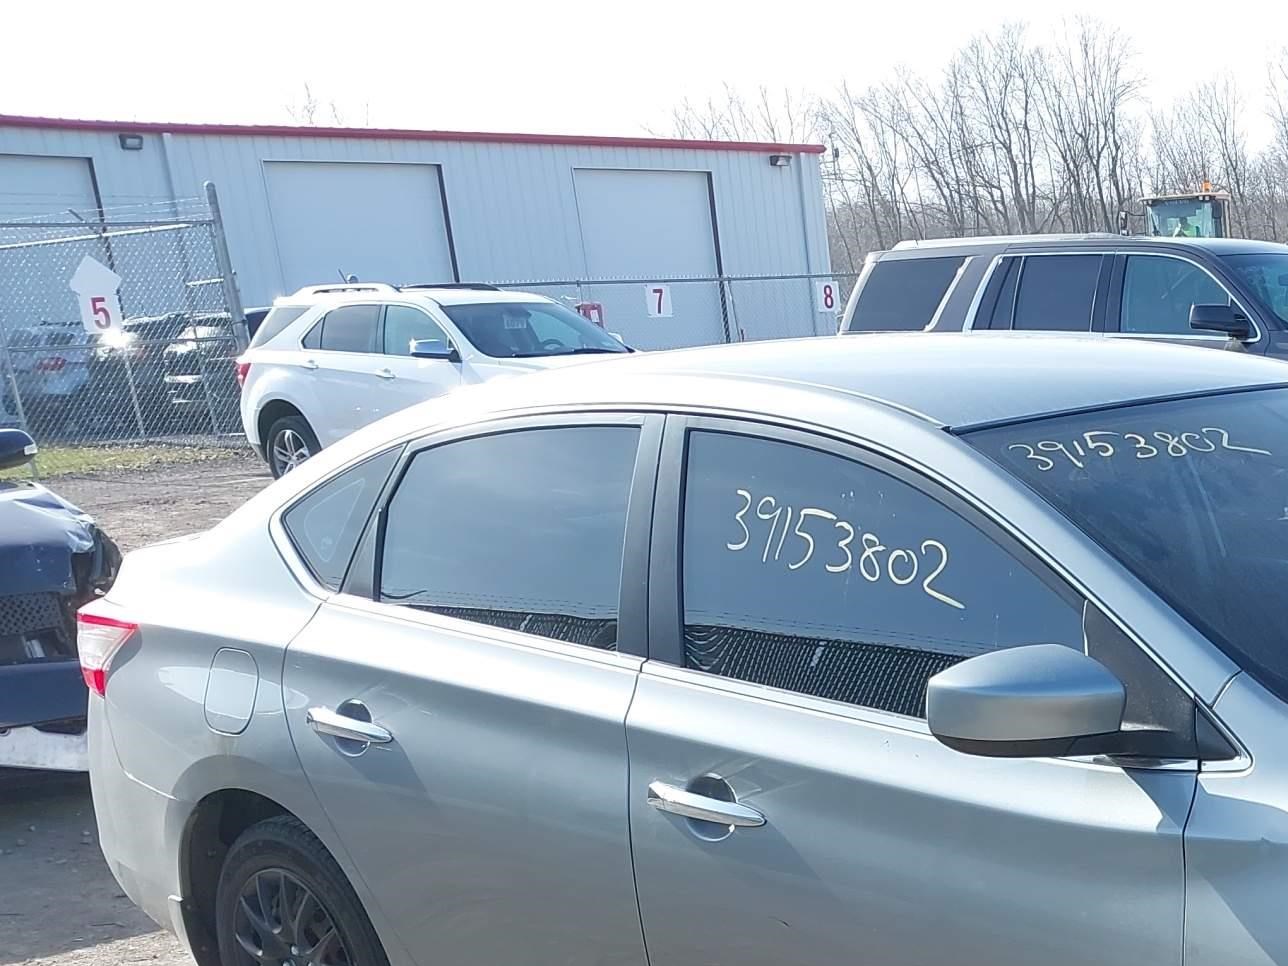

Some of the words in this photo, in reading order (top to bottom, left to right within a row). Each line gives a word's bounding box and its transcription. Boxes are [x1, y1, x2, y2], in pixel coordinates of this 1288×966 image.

[91, 297, 111, 329] 5
[652, 288, 663, 315] 7
[823, 285, 834, 309] 8
[1008, 427, 1272, 471] 39153802
[726, 489, 966, 610] 39153802
